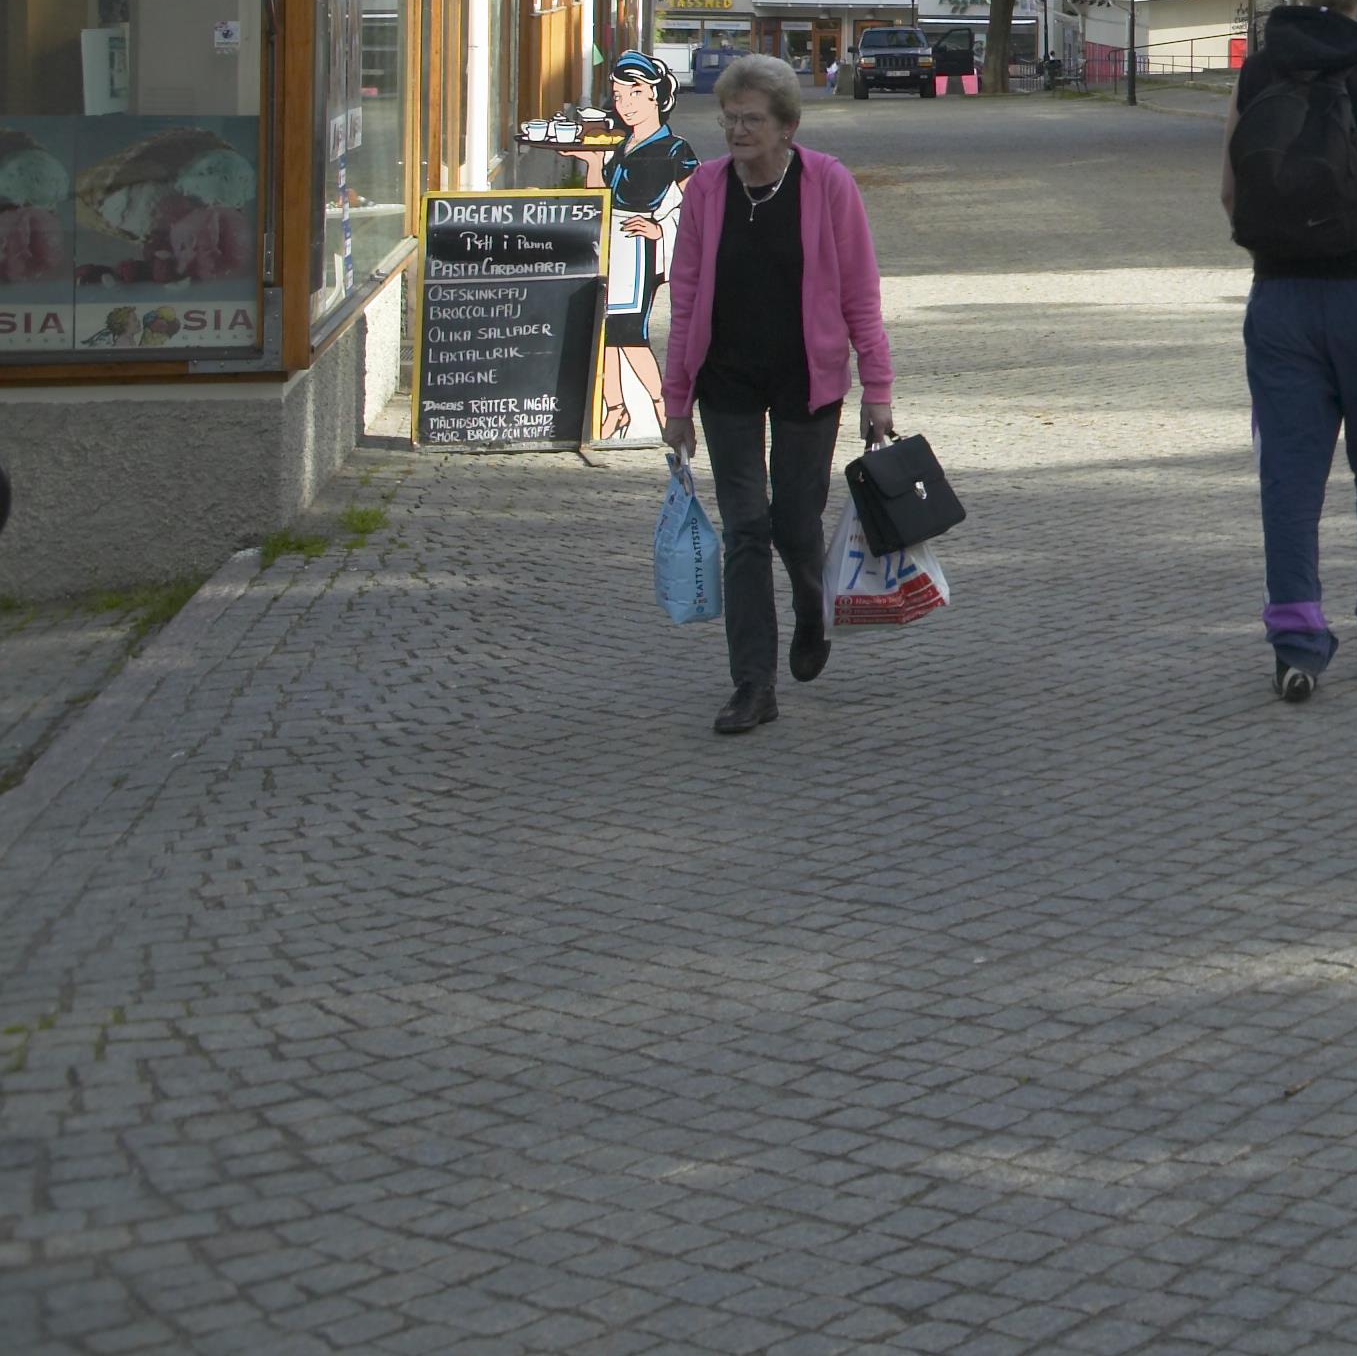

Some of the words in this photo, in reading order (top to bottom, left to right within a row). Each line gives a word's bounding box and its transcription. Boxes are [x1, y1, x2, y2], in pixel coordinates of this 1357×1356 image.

[434, 199, 513, 225] DAGENS
[522, 201, 570, 225] RÄTT
[503, 234, 509, 250] i
[430, 259, 479, 277] PASTA
[481, 257, 567, 276] CARBONARA
[0, 312, 65, 334] SIA
[183, 308, 254, 331] SIA
[428, 326, 471, 343] OLIKA
[477, 323, 556, 340] SALLADER
[428, 347, 525, 364] LAXTALLRIK
[427, 368, 498, 386] LASAGNE
[468, 397, 521, 414] RÄTTER
[523, 394, 561, 412] INGÅR
[467, 427, 499, 441] BRÖD
[523, 425, 557, 438] KAFFE
[695, 566, 704, 598] KATTY
